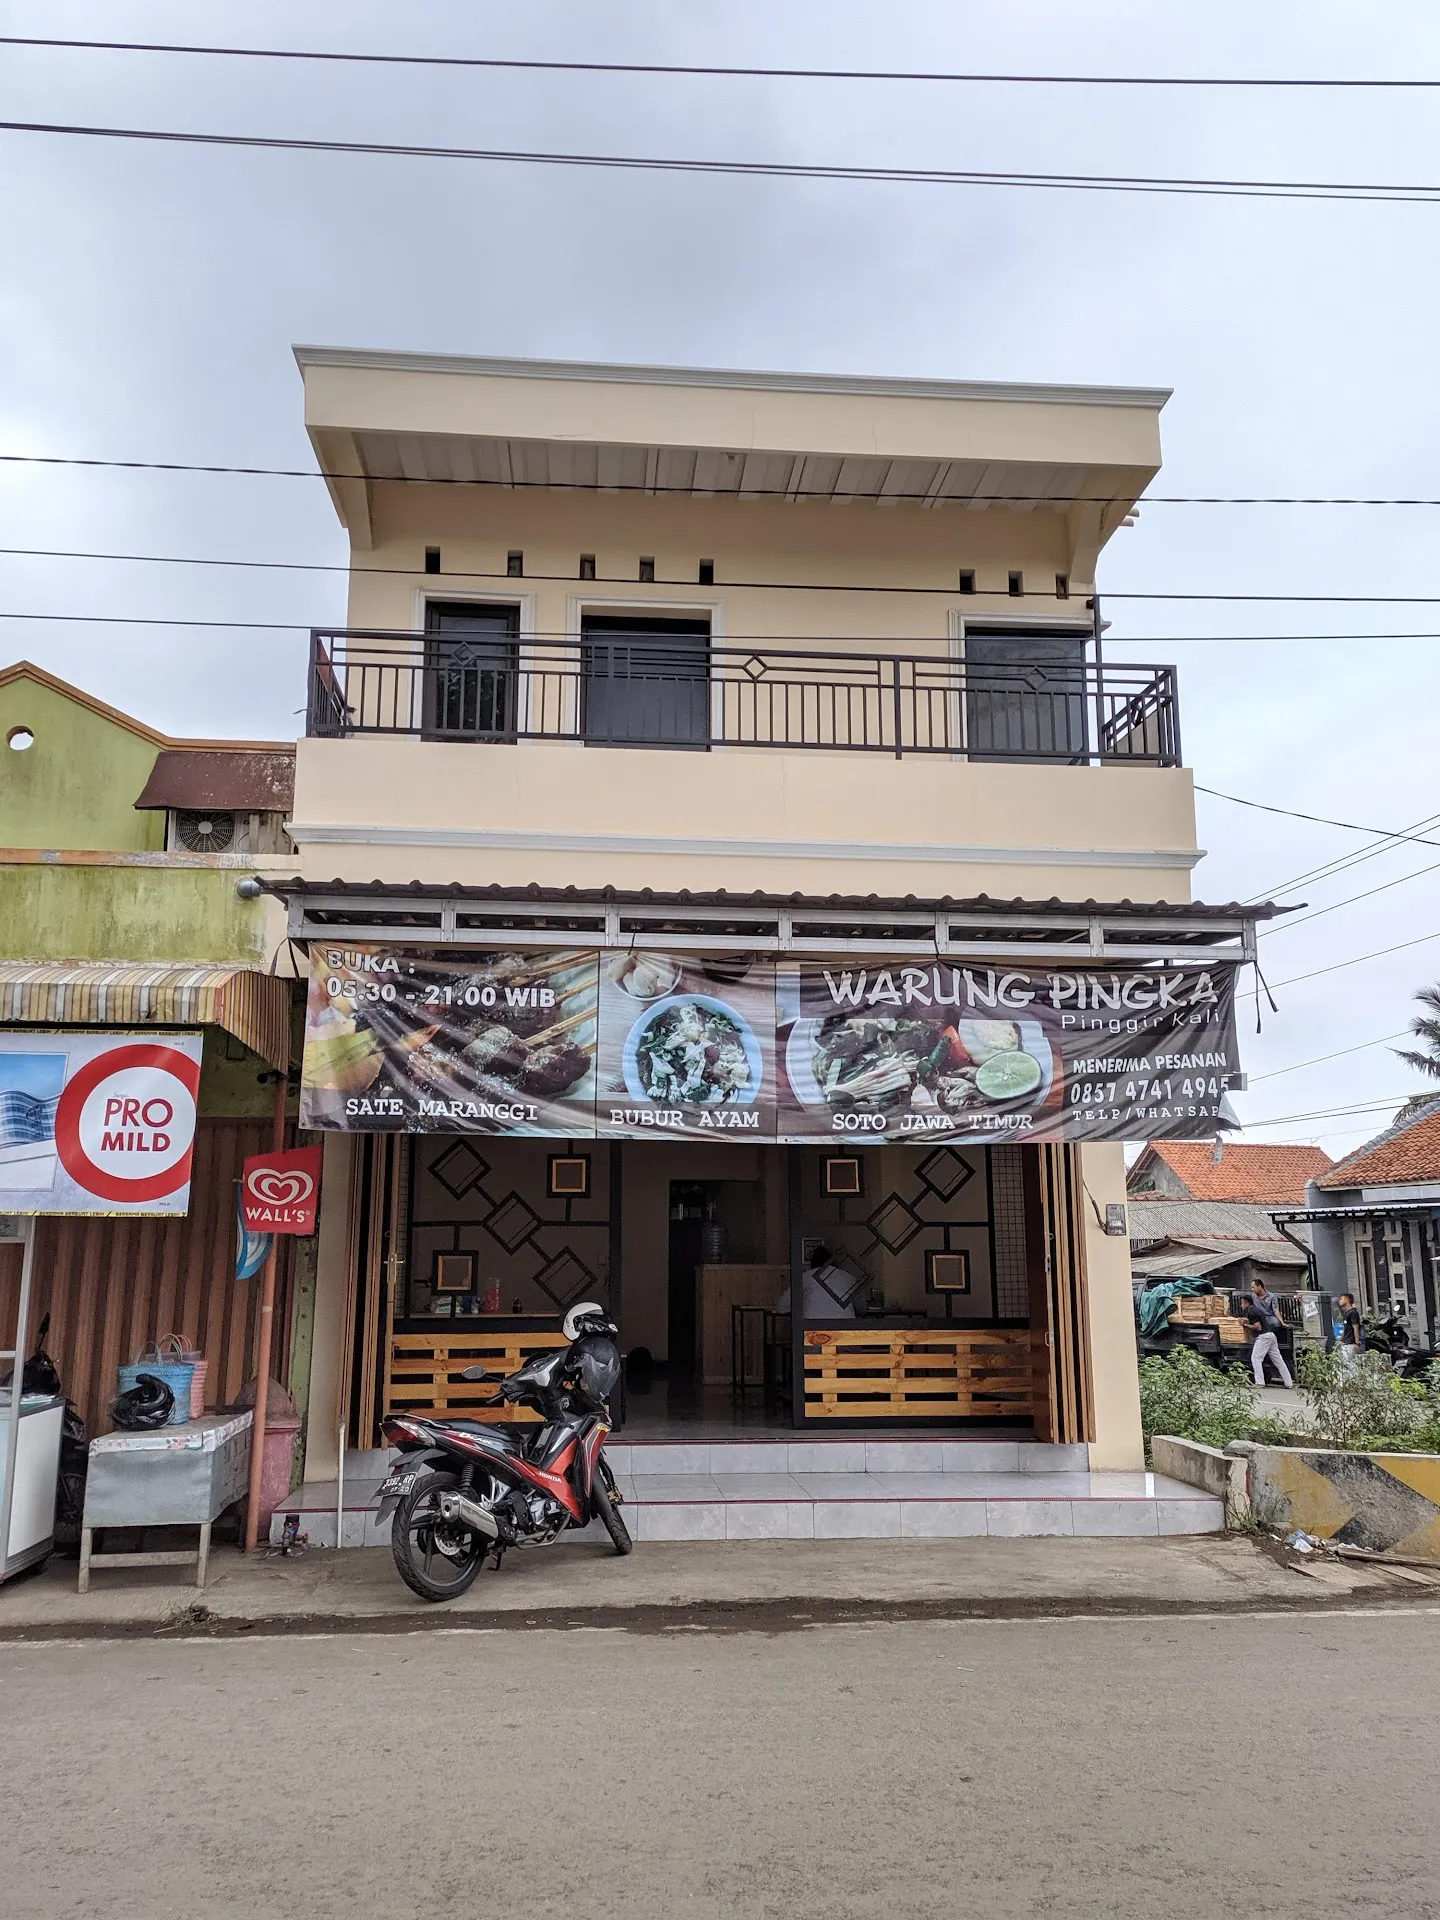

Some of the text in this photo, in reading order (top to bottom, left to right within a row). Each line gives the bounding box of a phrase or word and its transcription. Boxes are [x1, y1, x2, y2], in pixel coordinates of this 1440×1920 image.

[327, 950, 399, 974] BUKA
[327, 978, 397, 1003] 05.30
[424, 985, 497, 1007] 21.00
[505, 987, 556, 1008] WIB
[822, 967, 1218, 1010] WARUNG PINGKA
[1062, 1008, 1219, 1034] Pinggir Kali
[1073, 1052, 1227, 1074] MENERIMA PESANAN
[1070, 1082, 1117, 1104] 0857
[1125, 1079, 1172, 1101] 4741
[104, 1098, 173, 1128] PRO
[345, 1099, 538, 1121] SATE MARANGGI
[609, 1109, 759, 1129] BUBUR AYAM
[831, 1113, 1034, 1131] SOTO JAWA TIMUR
[101, 1132, 171, 1152] MILD
[245, 1206, 306, 1223] WALL'S
[539, 1470, 562, 1484] HONDA
